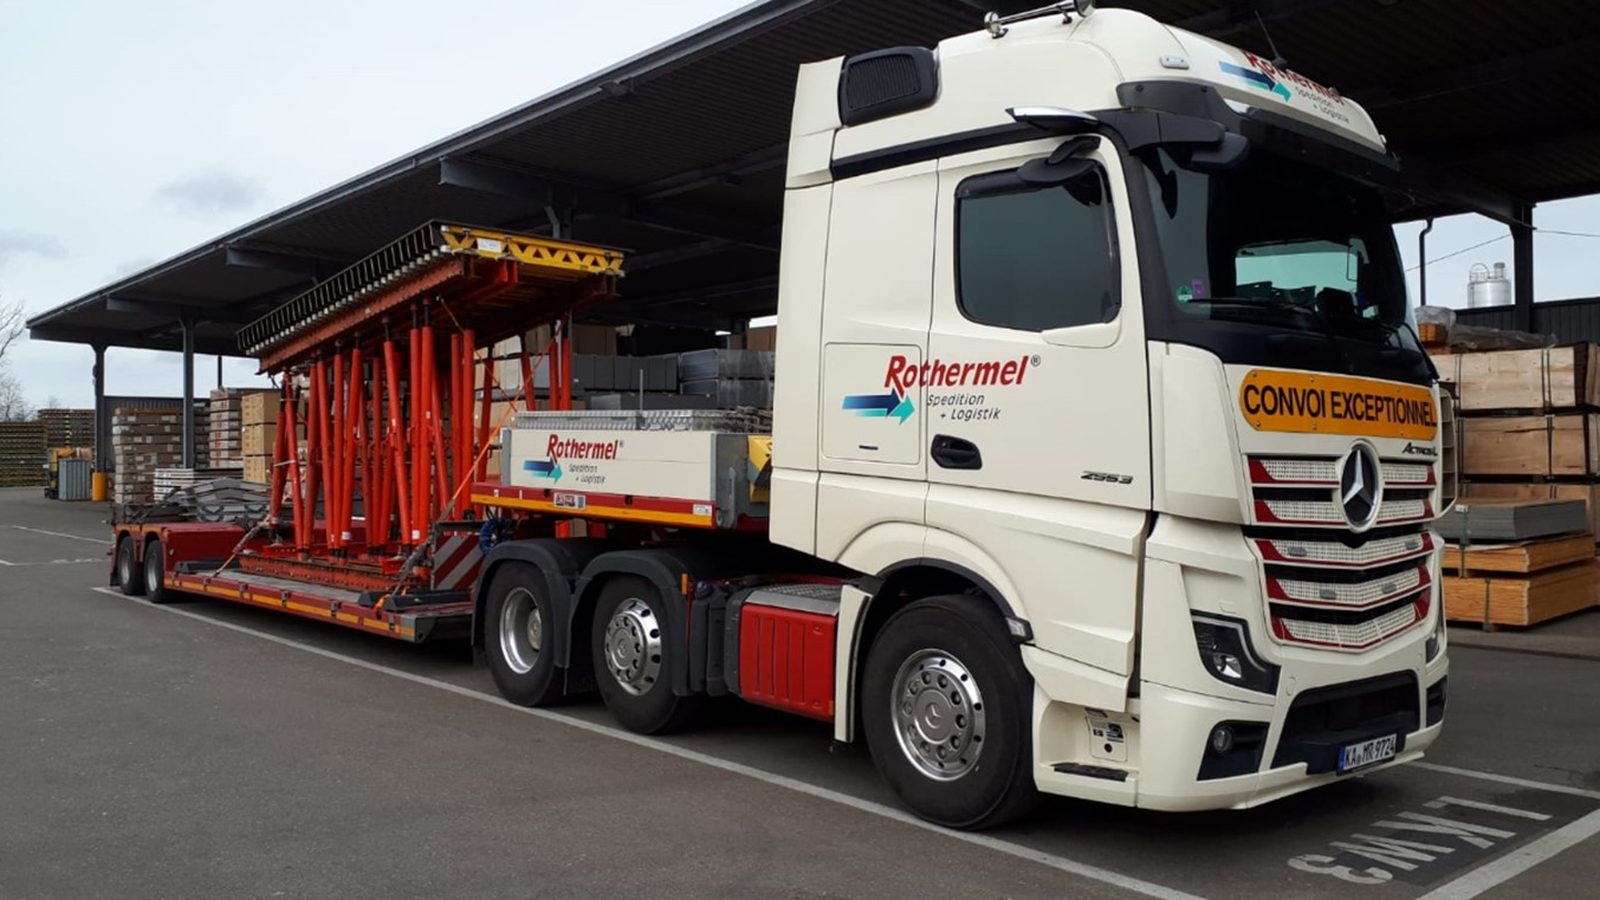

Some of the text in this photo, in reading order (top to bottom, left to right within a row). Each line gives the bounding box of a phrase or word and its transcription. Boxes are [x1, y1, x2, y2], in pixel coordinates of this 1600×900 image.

[927, 393, 985, 408] Spedition
[1243, 384, 1438, 428] CONVOI EXCEPTIONNEL
[950, 408, 1001, 422] Logistik
